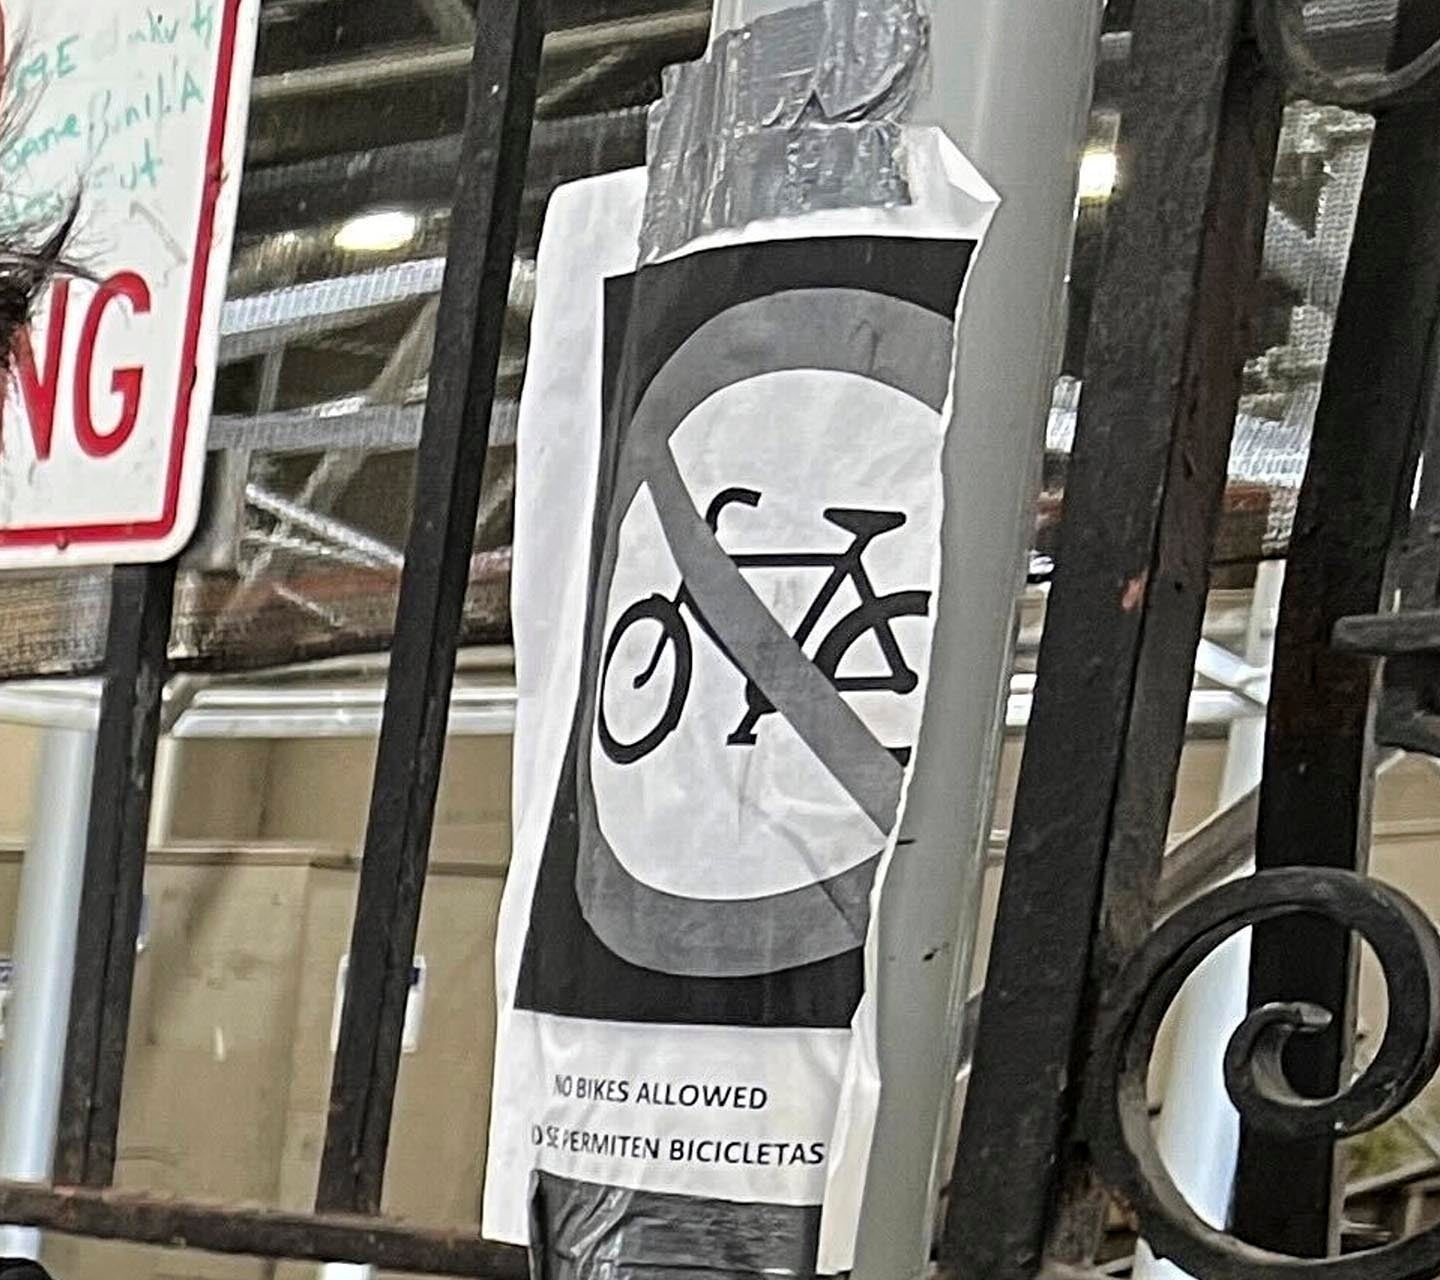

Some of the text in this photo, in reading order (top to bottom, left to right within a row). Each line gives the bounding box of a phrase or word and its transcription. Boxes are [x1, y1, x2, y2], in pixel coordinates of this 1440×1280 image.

[552, 1074, 768, 1109] NO BIKES ALLOWED
[562, 1130, 660, 1159] PERMITEN
[669, 1139, 825, 1166] BICICLETAS
